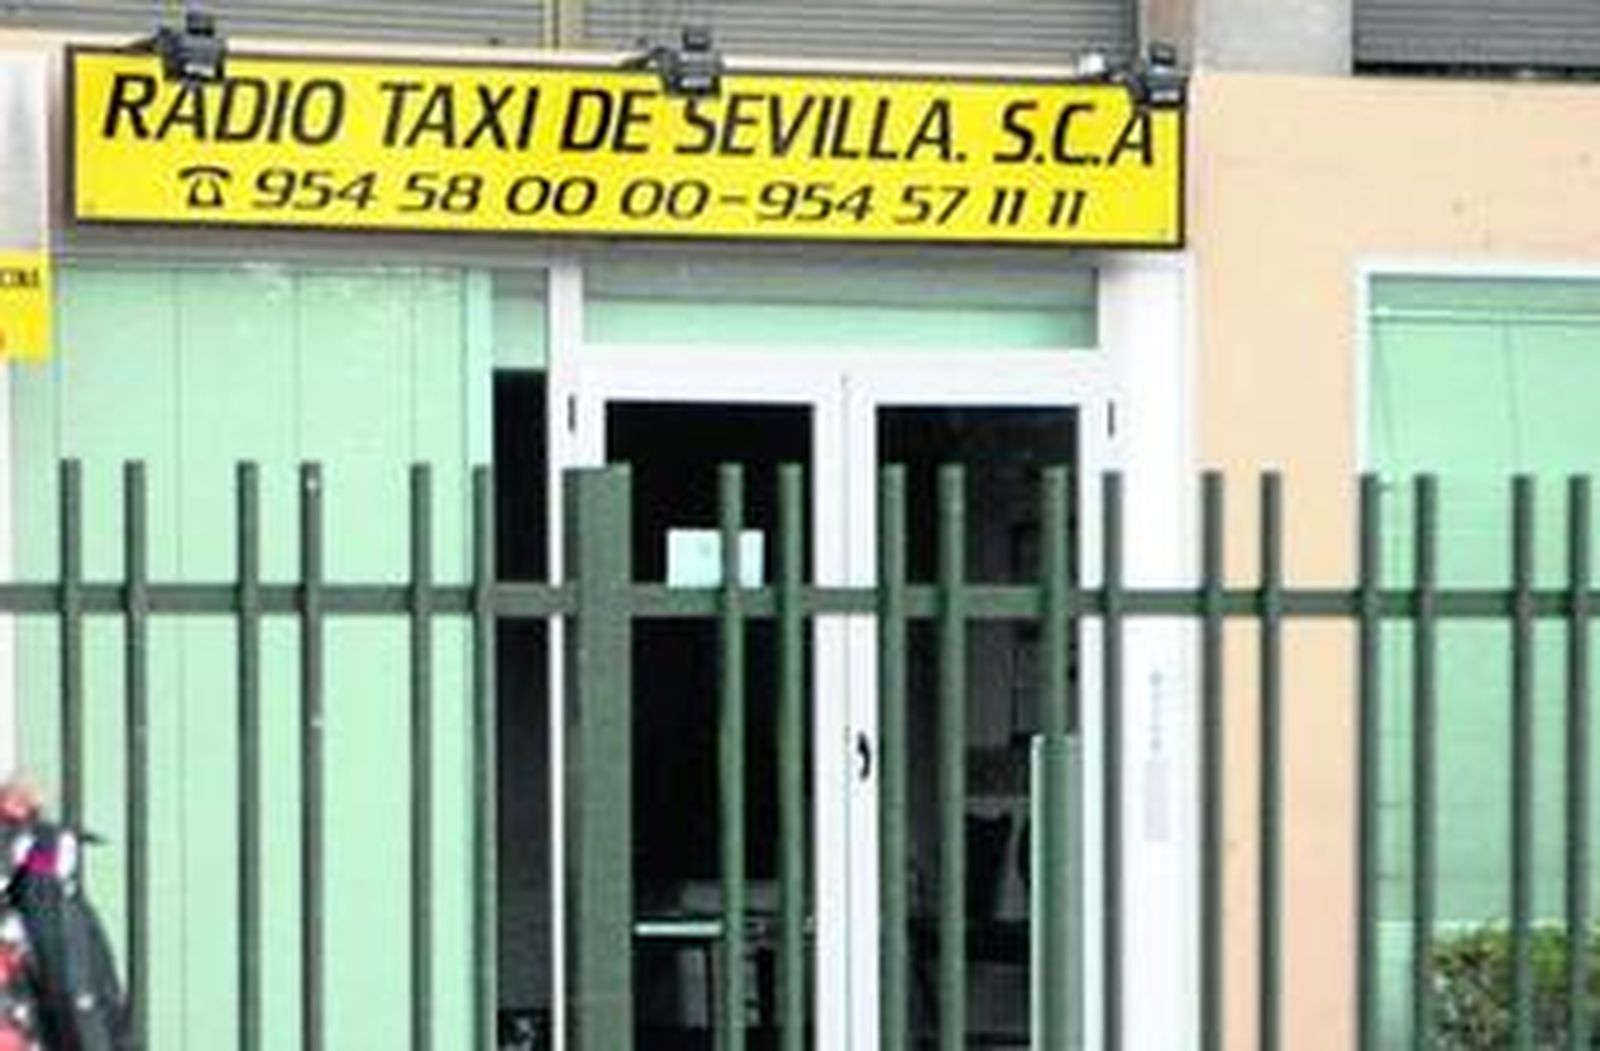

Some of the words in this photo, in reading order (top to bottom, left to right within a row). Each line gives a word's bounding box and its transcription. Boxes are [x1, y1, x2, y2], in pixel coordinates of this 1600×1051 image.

[101, 72, 346, 147] RADIO
[379, 82, 539, 151] TAXI
[560, 87, 657, 154] DE
[676, 90, 967, 163] SEVILLA.
[253, 168, 377, 212] 954
[402, 173, 483, 215] 58
[506, 176, 597, 218] 00
[895, 185, 967, 226] 57
[987, 187, 1027, 226] 11
[1048, 189, 1087, 229] 11
